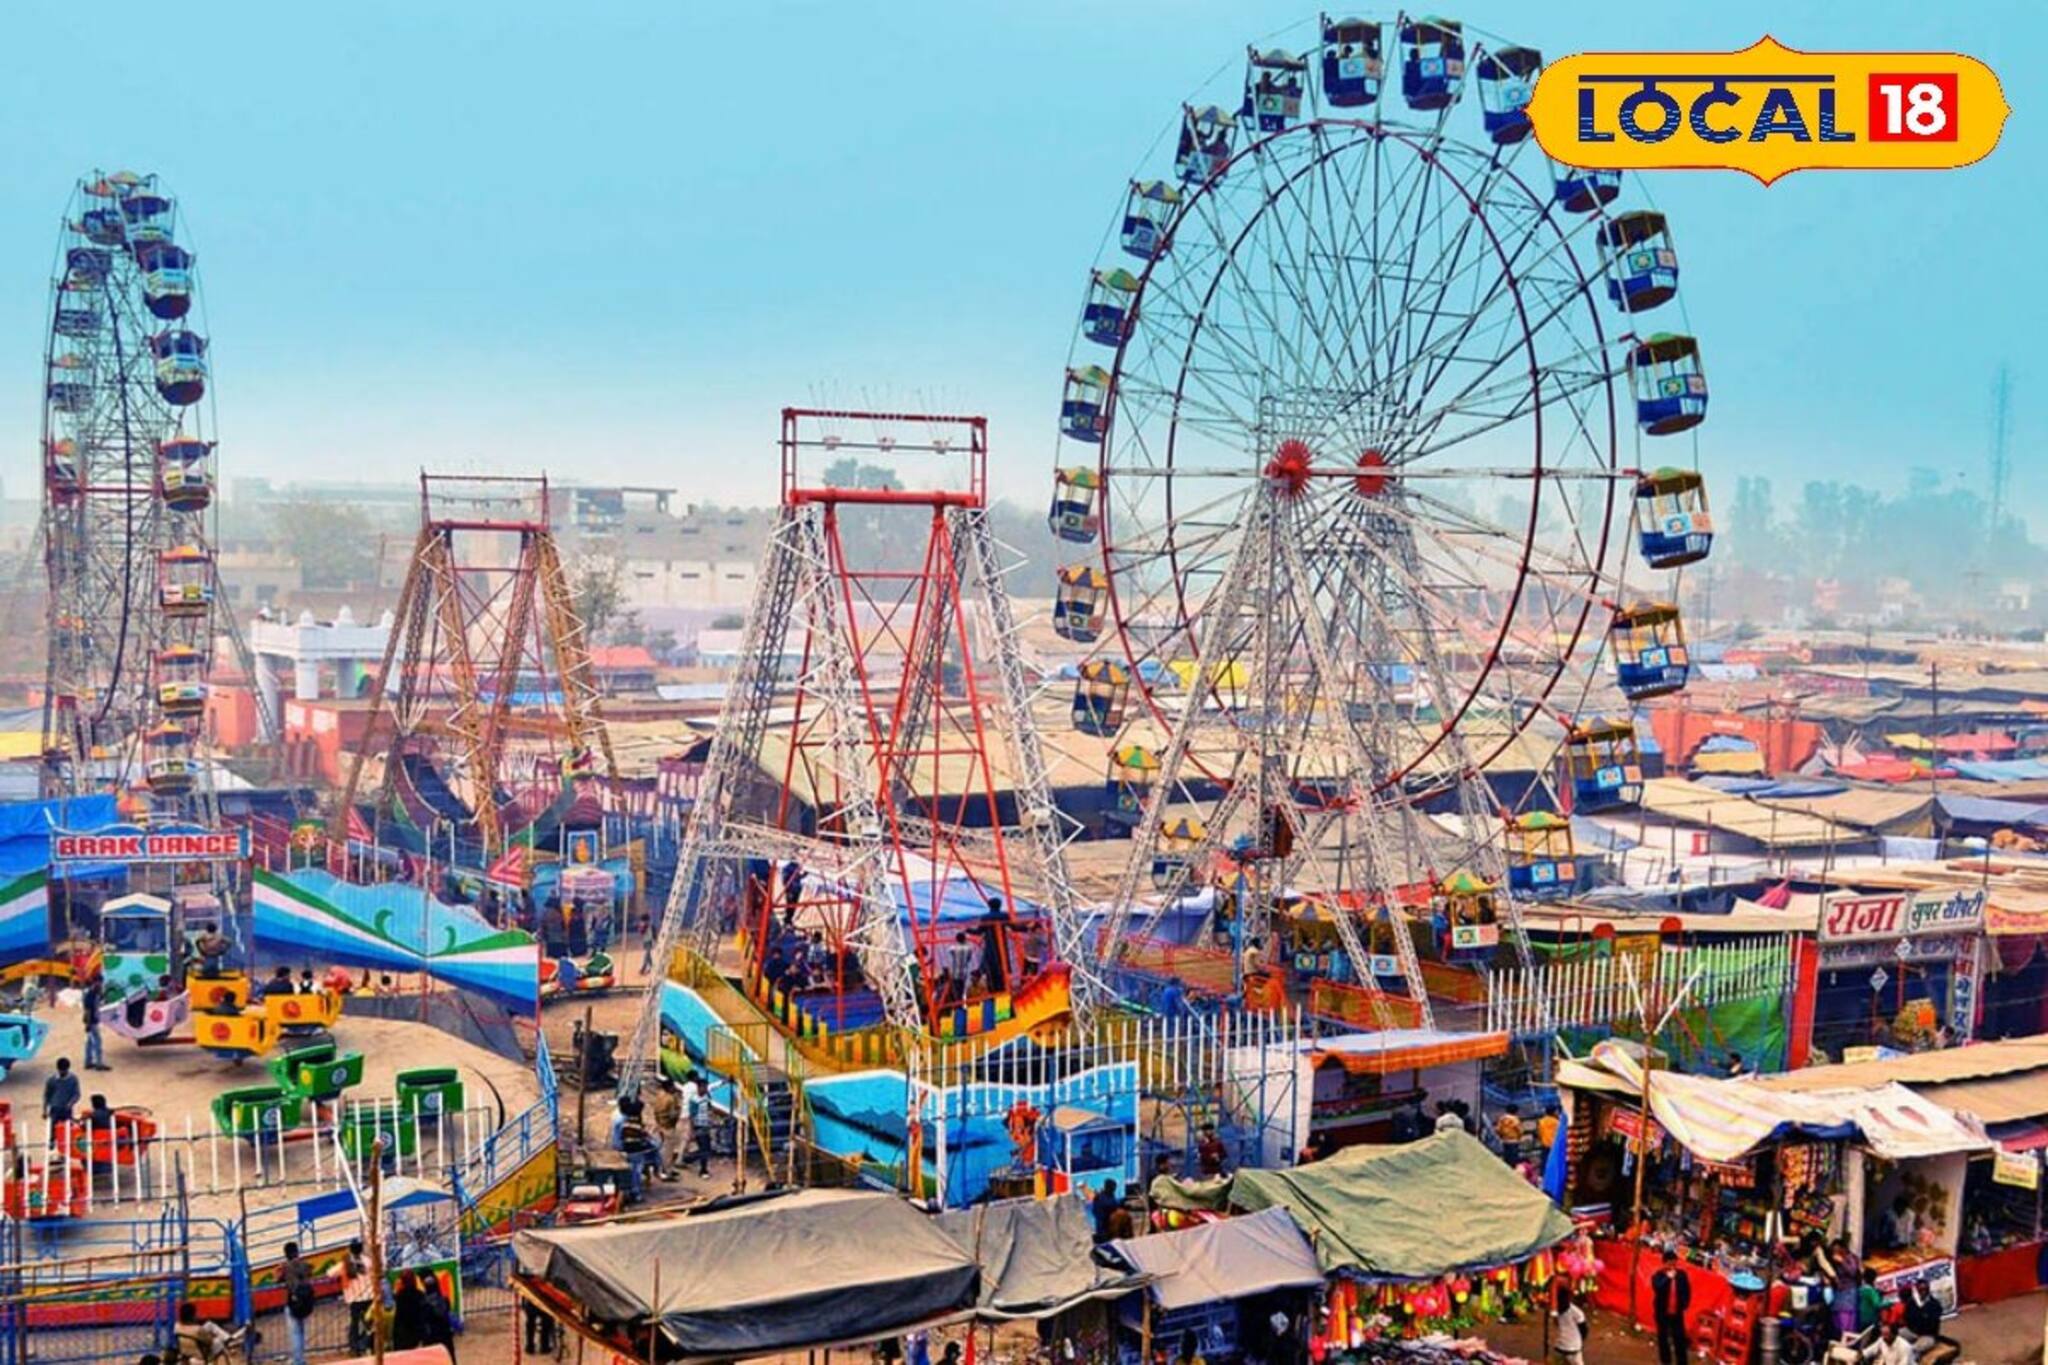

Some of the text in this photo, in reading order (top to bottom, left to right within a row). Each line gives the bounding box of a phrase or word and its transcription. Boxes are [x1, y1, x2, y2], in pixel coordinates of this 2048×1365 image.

[58, 834, 239, 857] BRAK DANCE
[1827, 898, 1906, 937] राजा
